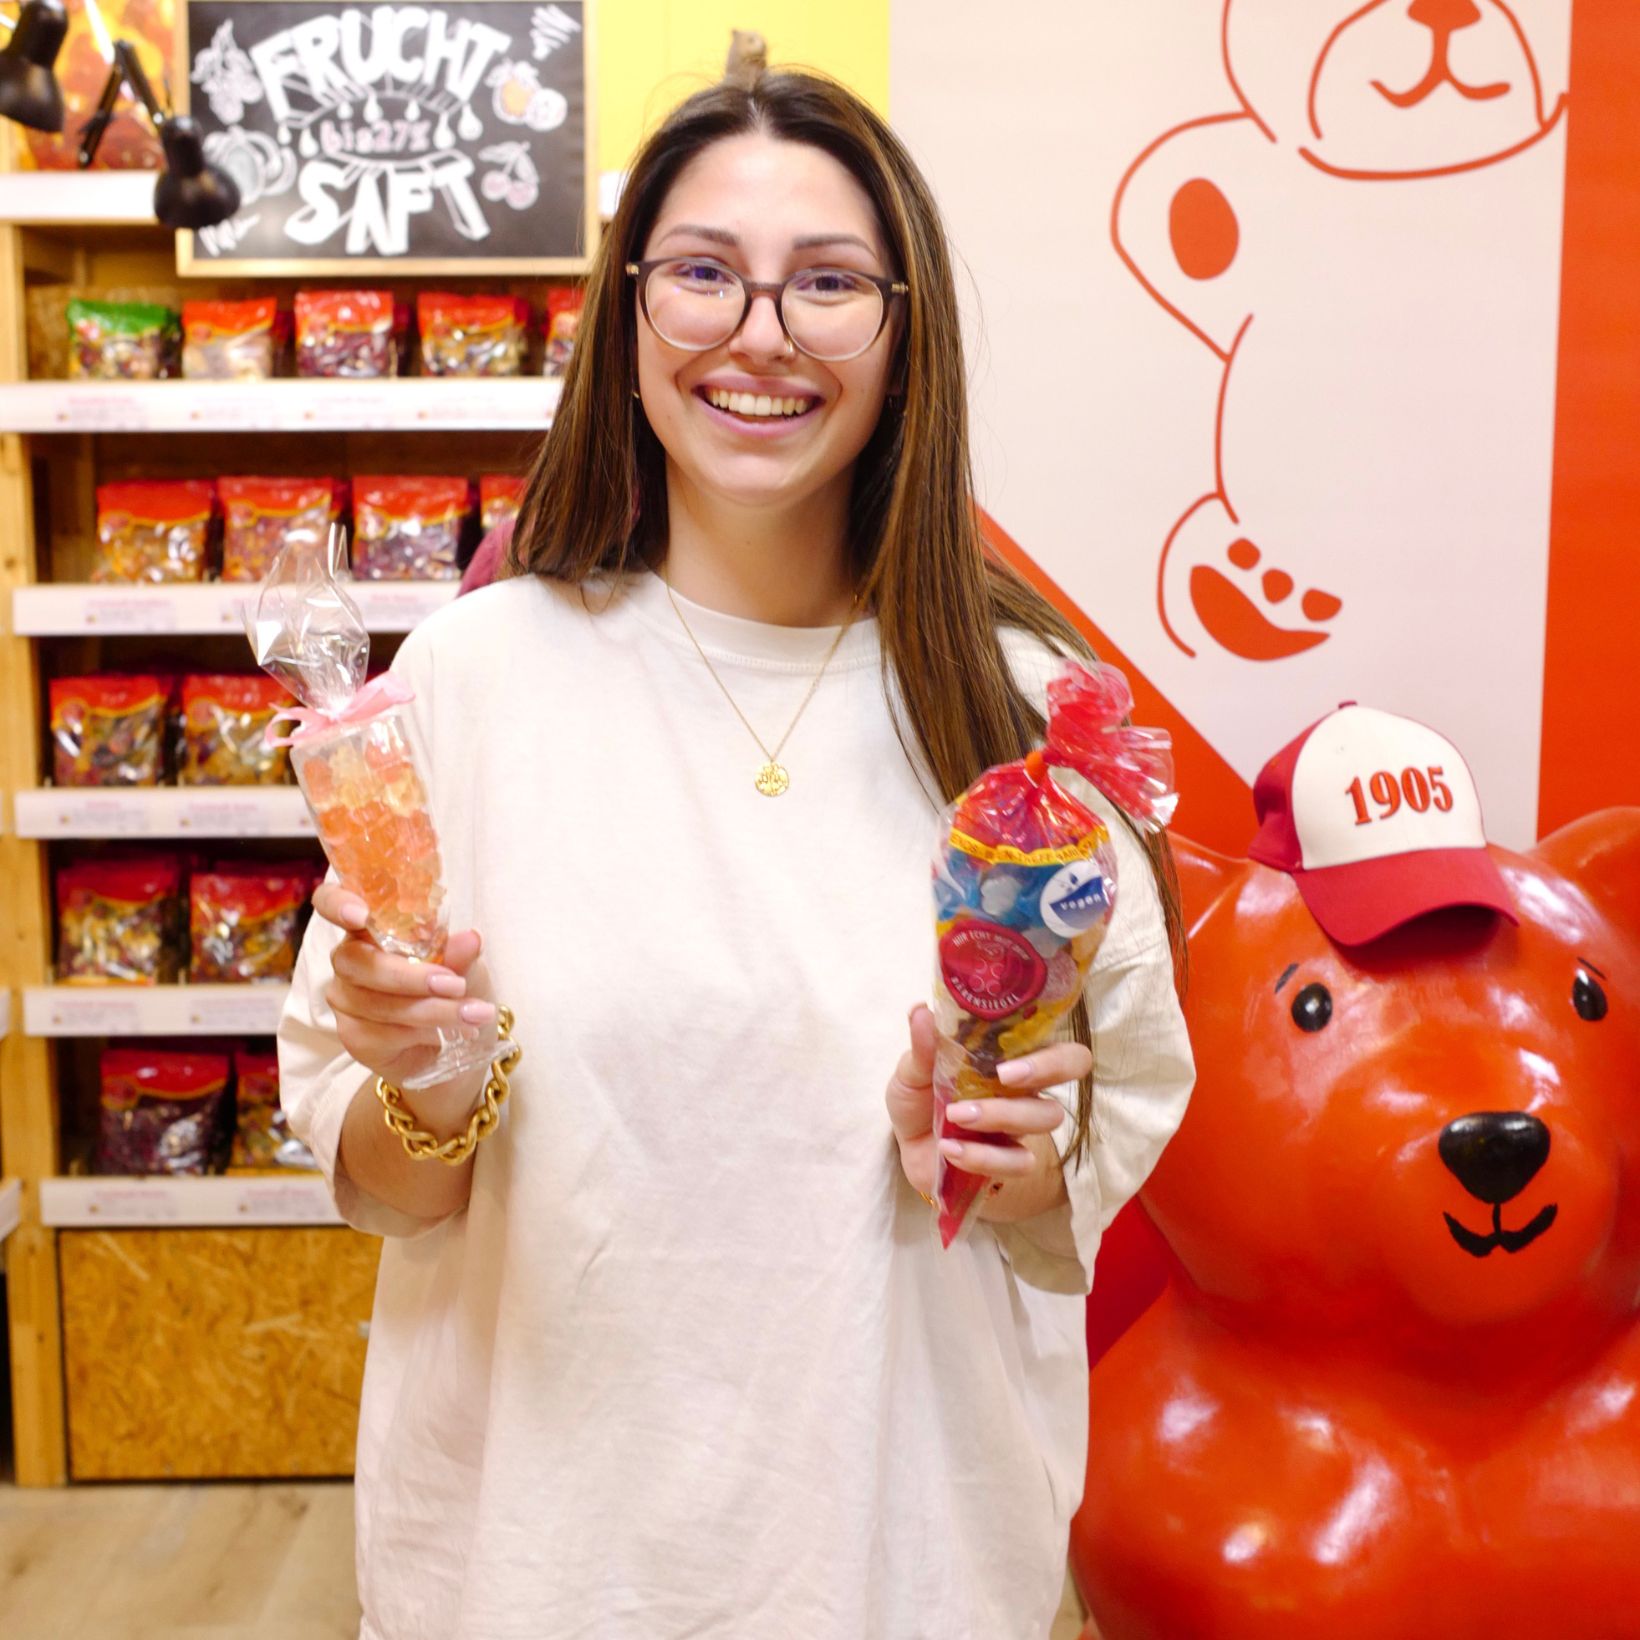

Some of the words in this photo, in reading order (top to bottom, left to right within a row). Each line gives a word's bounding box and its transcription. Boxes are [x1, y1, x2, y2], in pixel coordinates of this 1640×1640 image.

[251, 6, 511, 122] FRUCHT
[284, 155, 490, 255] SAFT
[1345, 766, 1453, 826] 1905
[1060, 893, 1102, 911] vegan
